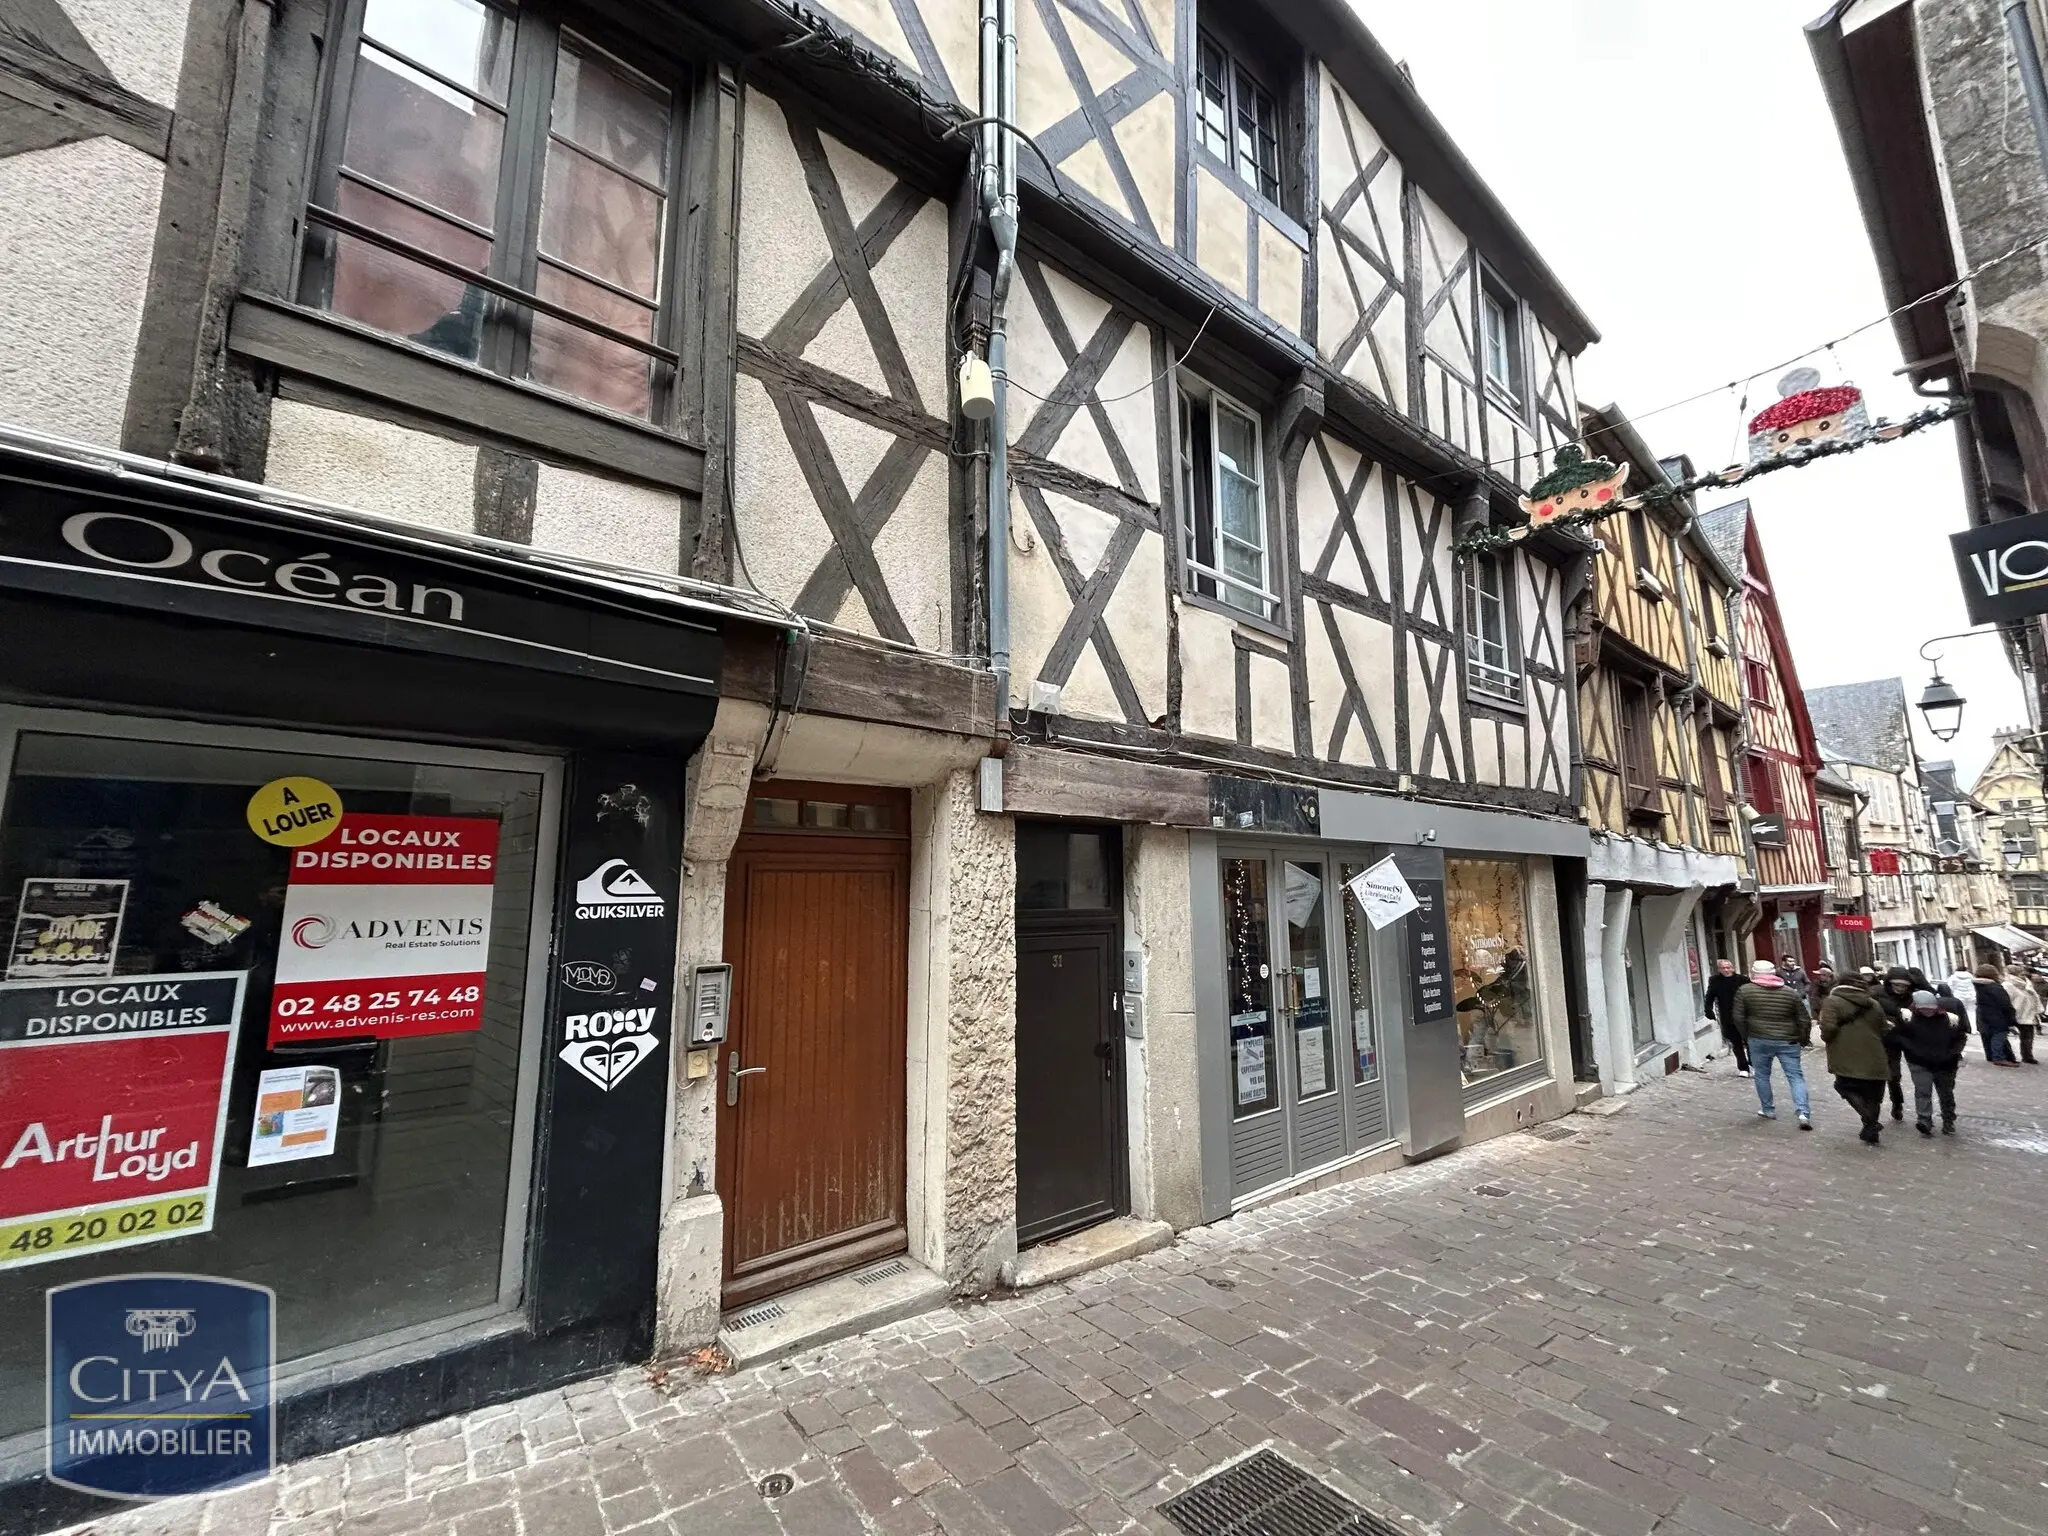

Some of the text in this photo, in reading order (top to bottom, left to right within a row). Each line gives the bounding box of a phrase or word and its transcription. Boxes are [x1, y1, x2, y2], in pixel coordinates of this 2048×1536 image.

[62, 511, 463, 622] Océan
[283, 787, 300, 806] A
[263, 802, 336, 837] LOUER
[340, 828, 461, 848] LOCAUX
[295, 851, 492, 870] DISPONIBLES
[575, 905, 665, 920] QUIKSILVER
[339, 917, 483, 940] ADVENIS
[385, 938, 481, 949] Real Estate Solutions
[56, 983, 182, 1007] LOCAUX
[277, 986, 479, 1017] 02 48 25 74 48
[26, 1006, 208, 1036] DISPONIBLES
[281, 1007, 475, 1033] www.advenis-res.com
[565, 1007, 656, 1041] ROXY
[1, 1114, 167, 1169] Arthur
[92, 1139, 198, 1182] Loyd
[9, 1201, 204, 1252] 48 20 02 02
